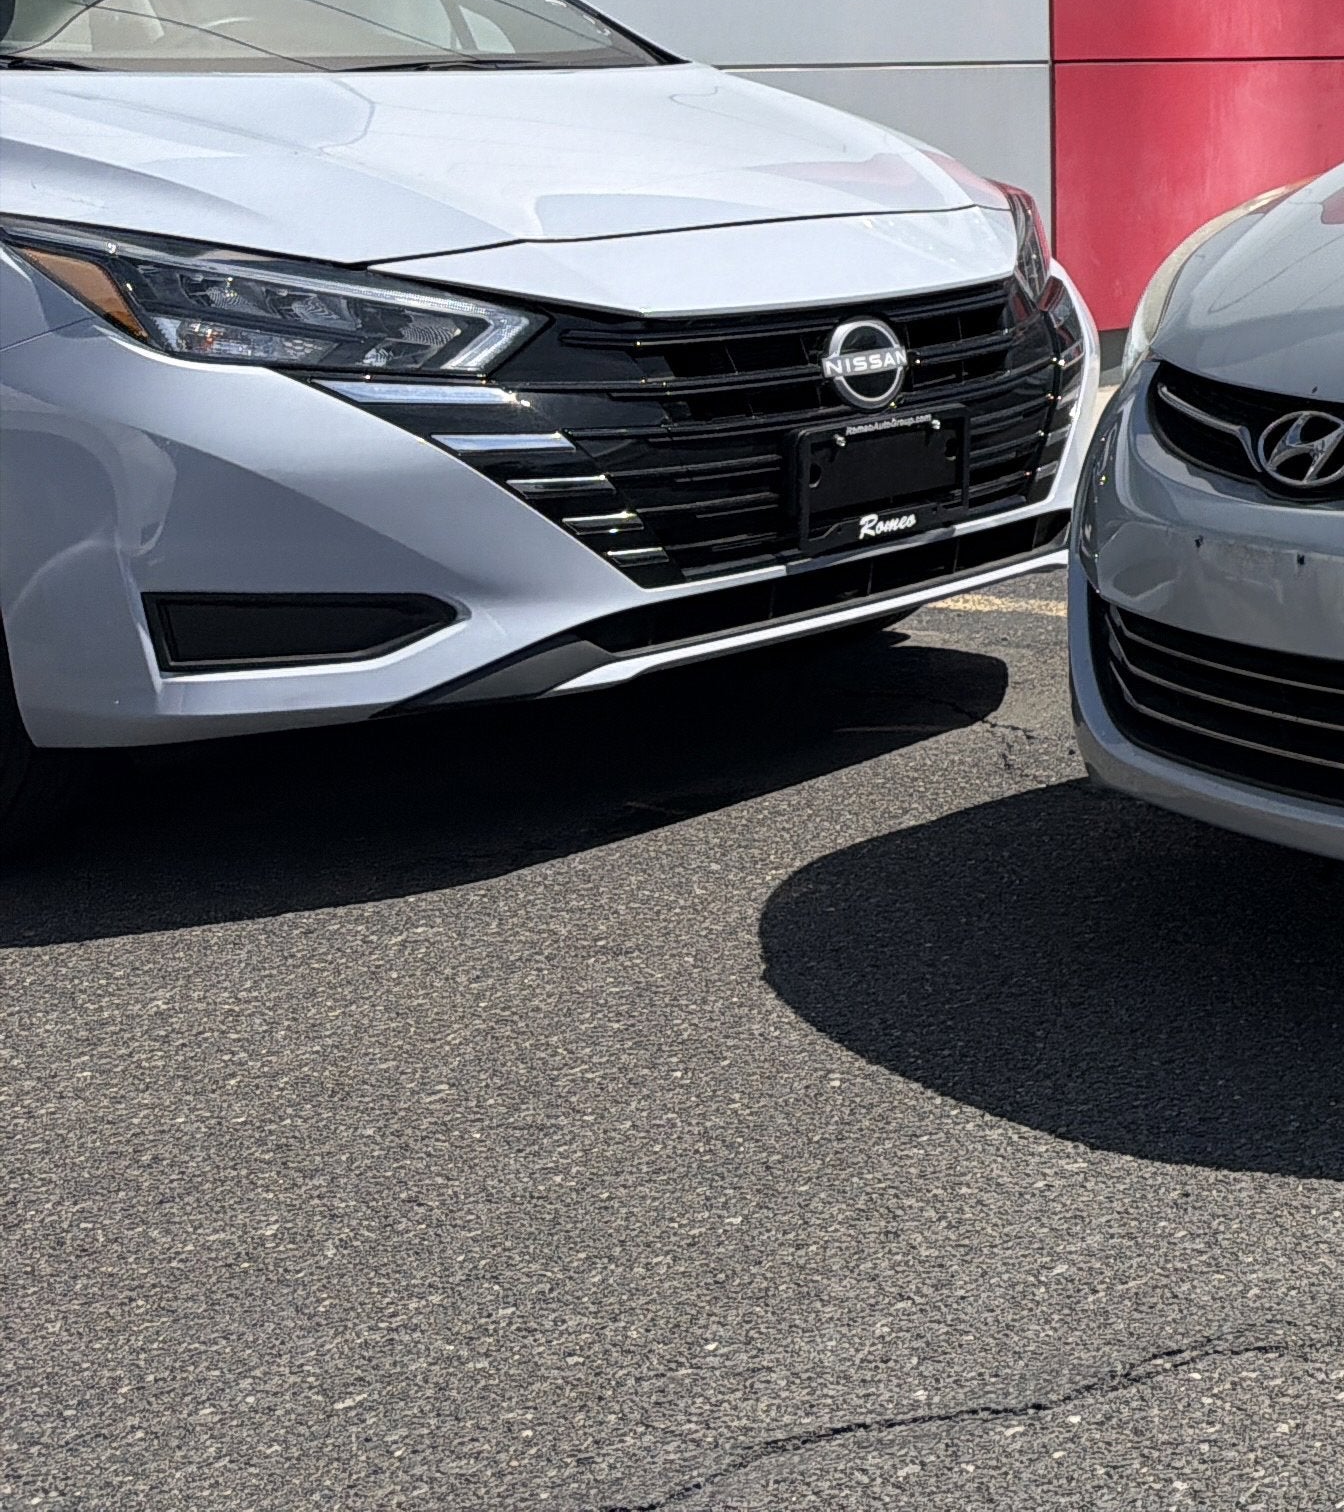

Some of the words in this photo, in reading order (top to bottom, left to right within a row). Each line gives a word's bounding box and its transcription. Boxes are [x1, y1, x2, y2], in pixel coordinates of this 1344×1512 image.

[825, 350, 907, 375] NISSAN
[845, 414, 932, 436] RomeoAutoGroup.com
[859, 513, 916, 539] Romeo
